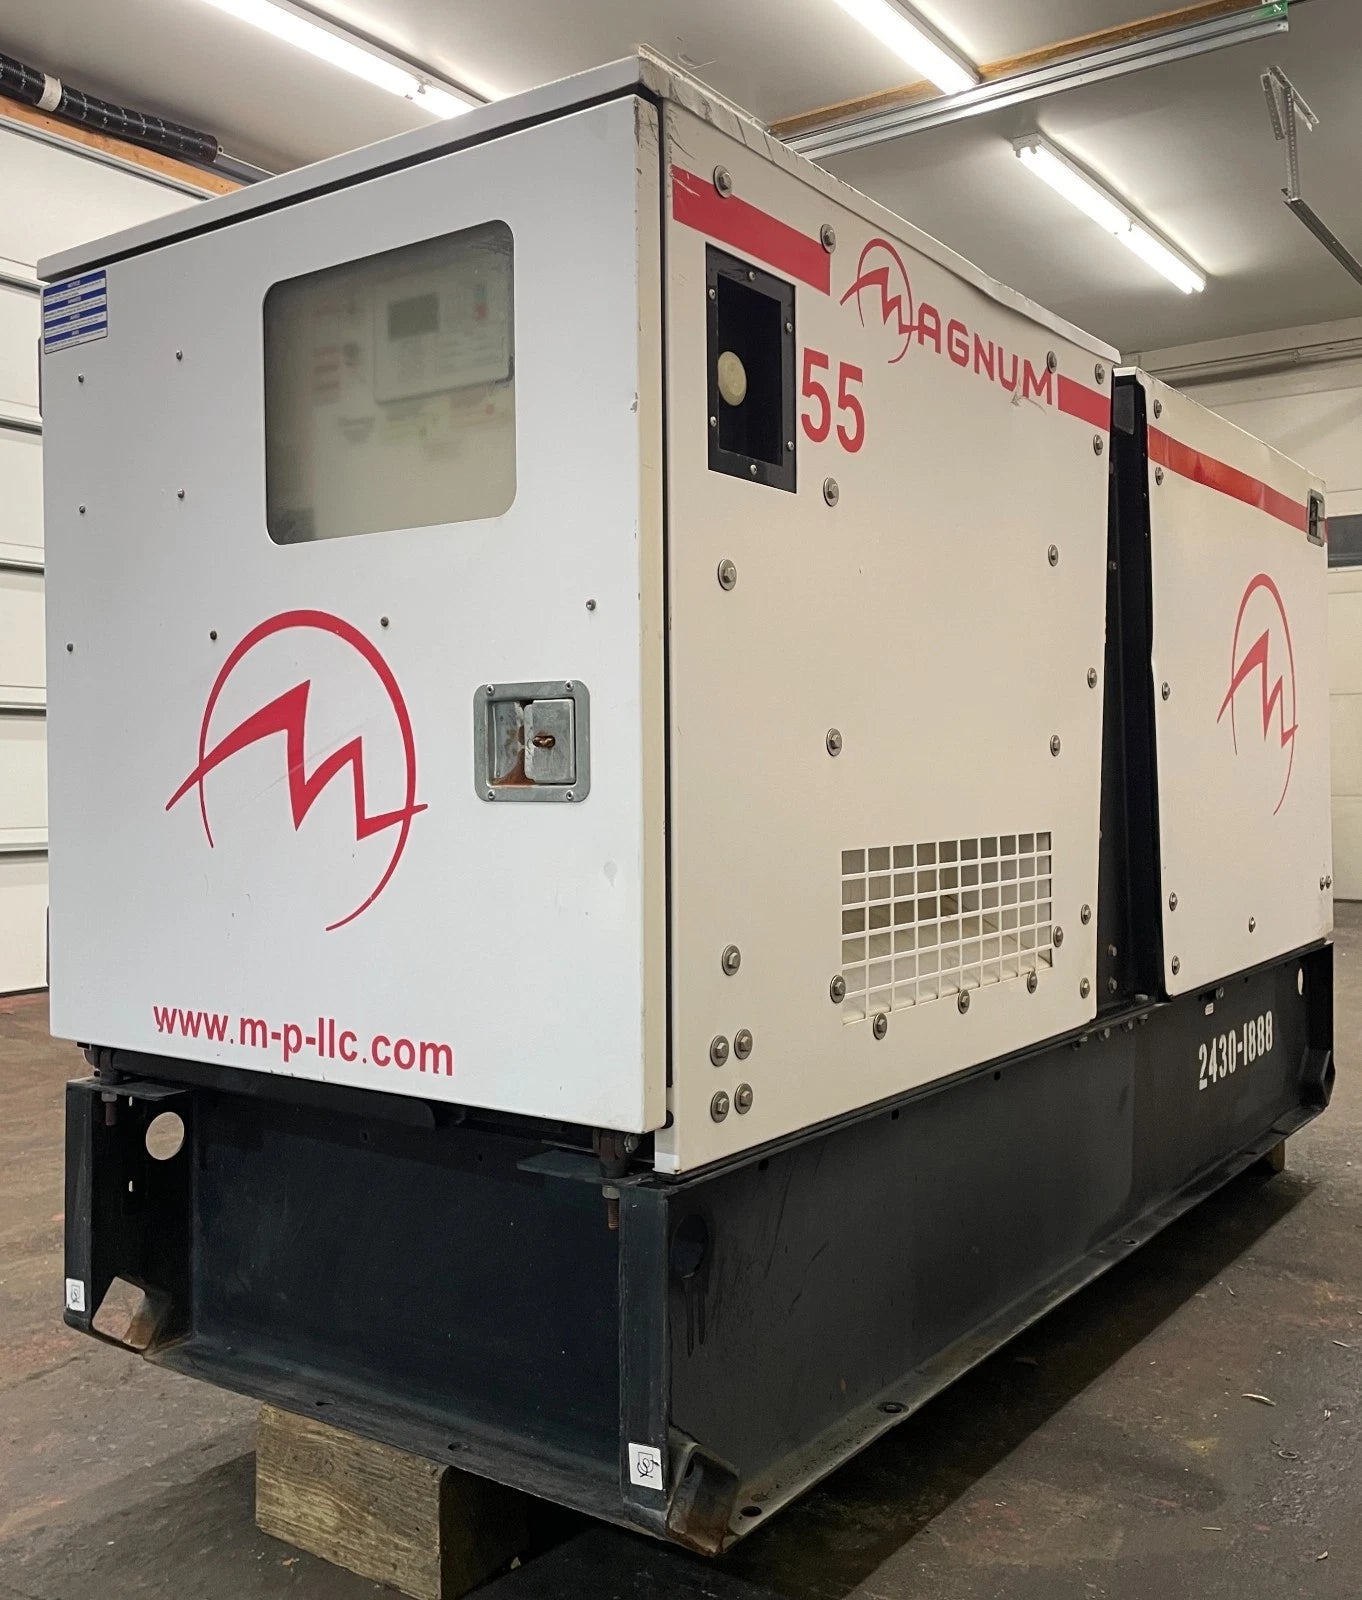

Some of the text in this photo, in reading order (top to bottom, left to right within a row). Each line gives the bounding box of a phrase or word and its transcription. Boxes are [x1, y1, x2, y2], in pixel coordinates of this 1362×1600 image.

[840, 264, 1053, 406] MAGNUM
[801, 346, 865, 453] 55
[153, 1005, 453, 1077] www.m-p-llc.com
[1198, 1010, 1273, 1091] 2430-1888
